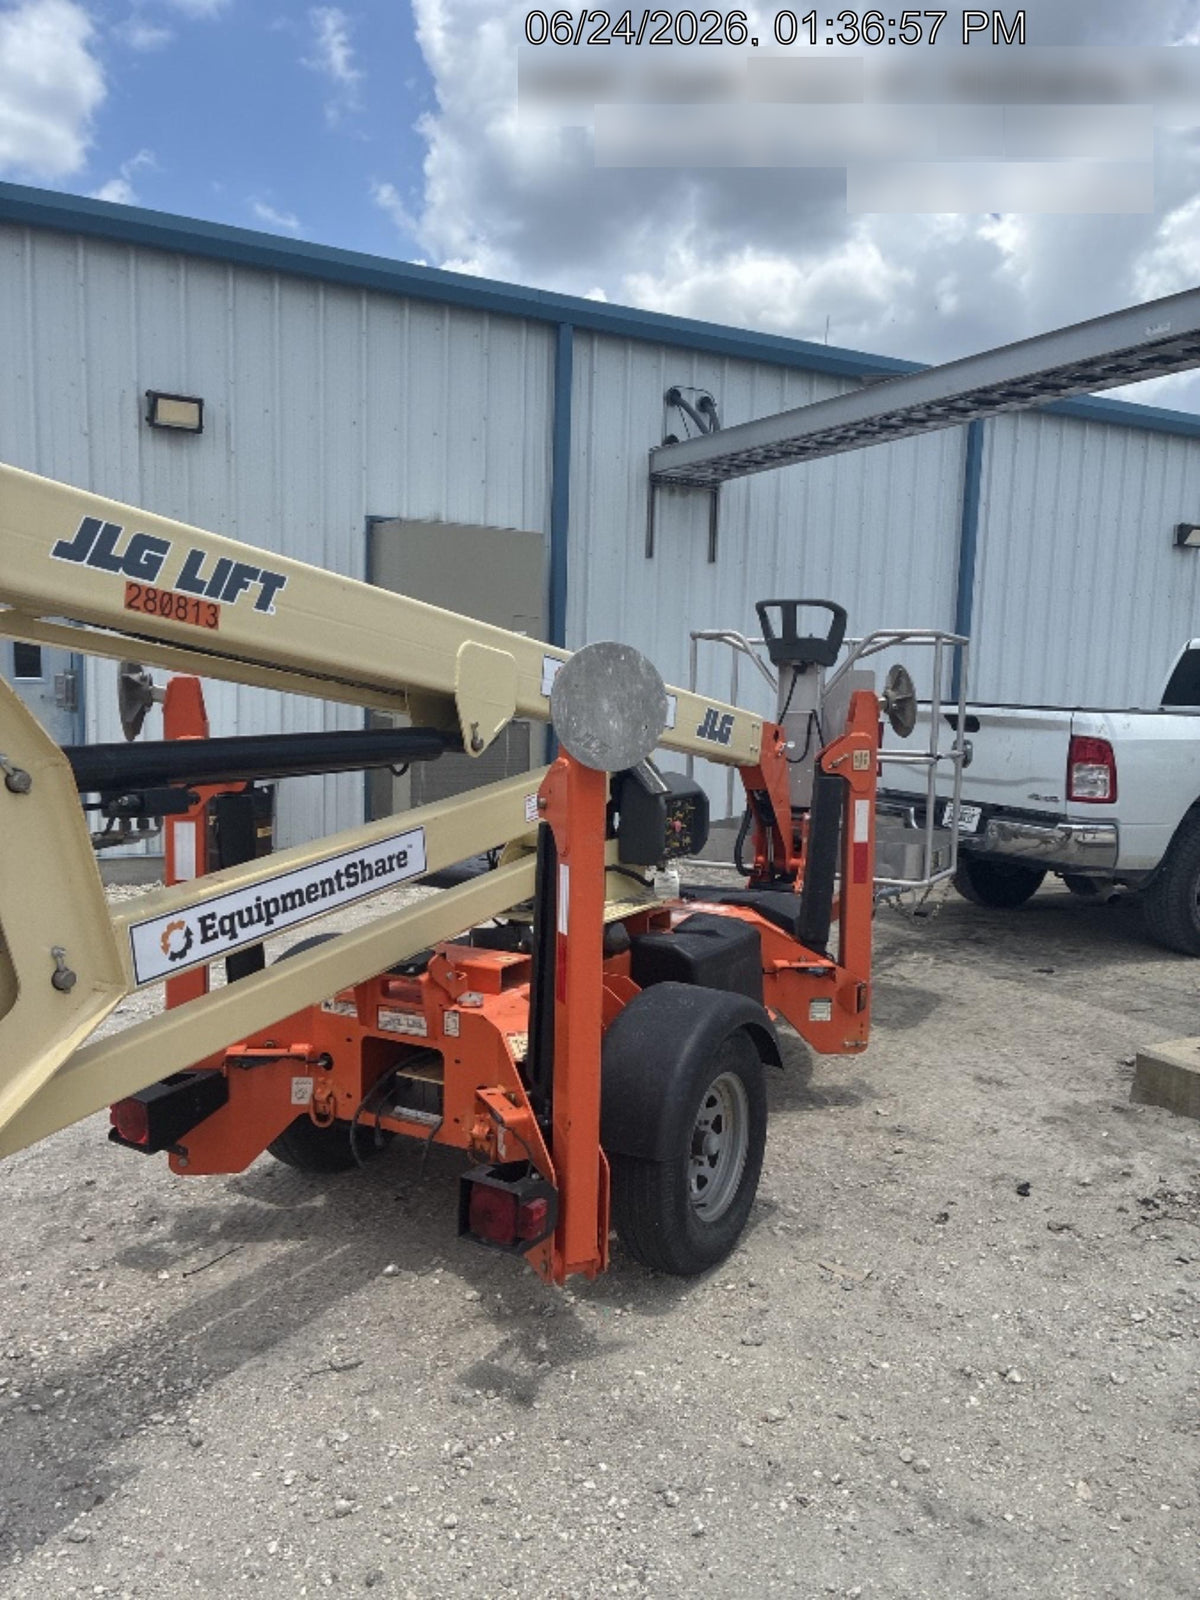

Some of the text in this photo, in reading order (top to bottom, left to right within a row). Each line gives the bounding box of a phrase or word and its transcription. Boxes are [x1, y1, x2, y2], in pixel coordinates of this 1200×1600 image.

[51, 517, 287, 613] JLG LIFT
[126, 583, 219, 629] 280813
[696, 707, 735, 746] JLG
[198, 849, 408, 944] EquipmentShare
